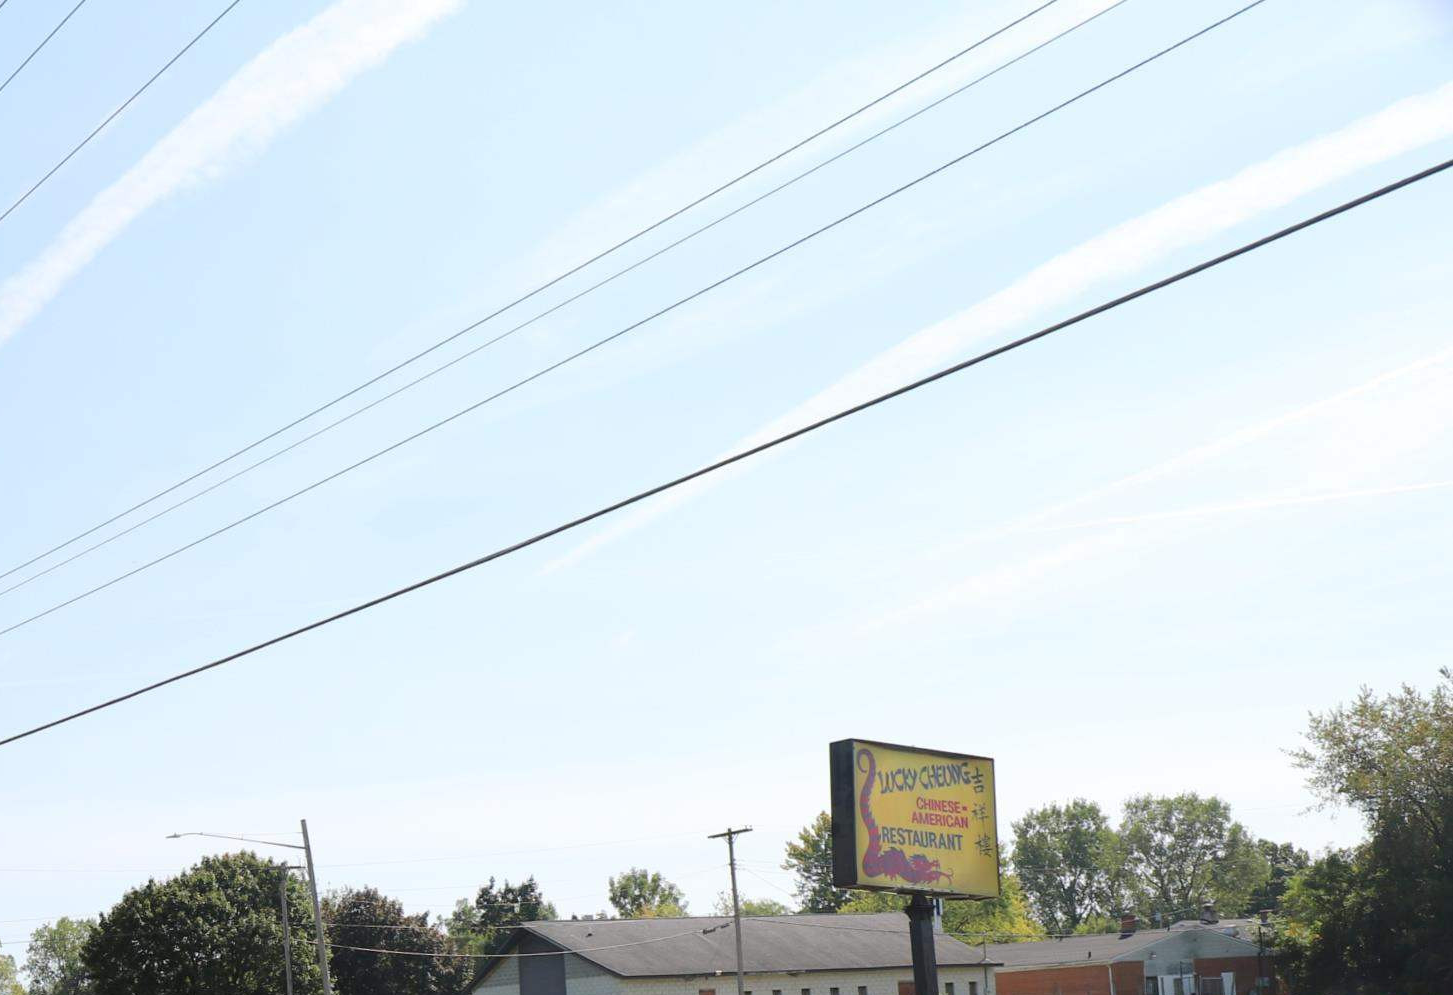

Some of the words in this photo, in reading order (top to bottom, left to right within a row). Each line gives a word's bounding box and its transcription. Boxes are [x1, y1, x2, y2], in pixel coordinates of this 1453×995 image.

[877, 767, 918, 794] LUCKY
[919, 762, 972, 790] CHEUNG
[911, 813, 969, 829] AMERICAN
[881, 826, 963, 852] RESTAURANT
